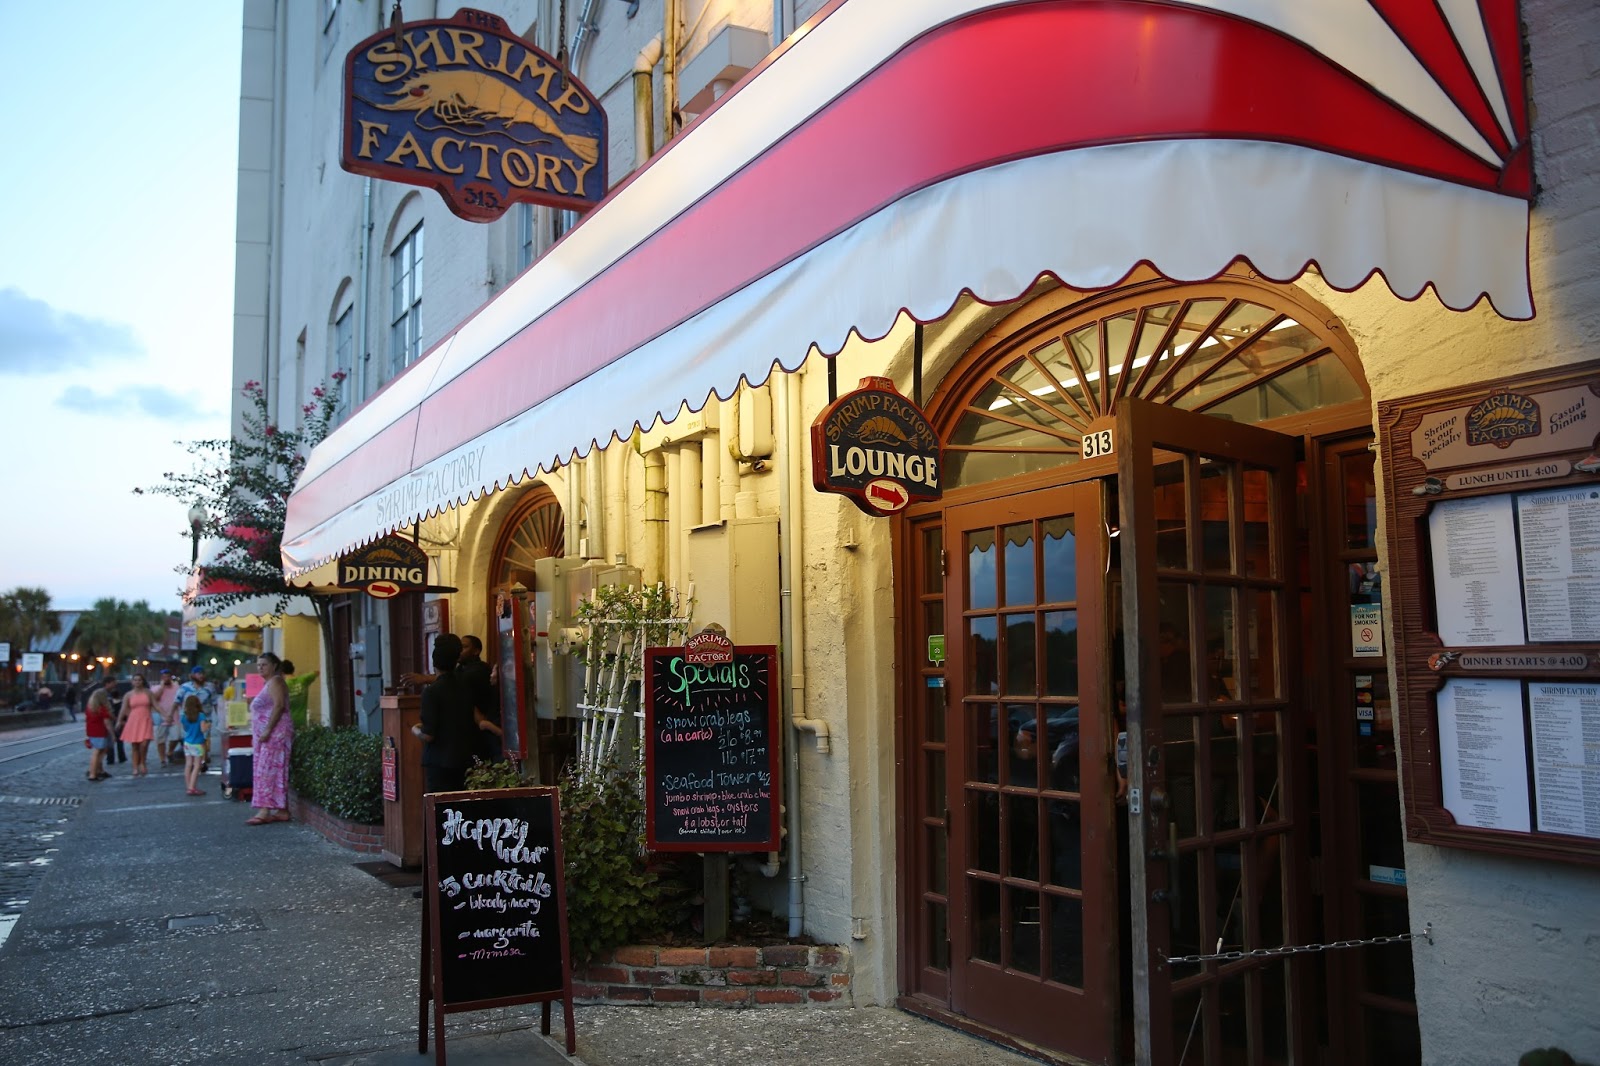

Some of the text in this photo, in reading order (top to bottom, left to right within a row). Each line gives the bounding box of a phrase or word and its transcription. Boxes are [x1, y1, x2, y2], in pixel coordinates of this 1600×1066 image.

[463, 10, 500, 29] THE
[366, 28, 590, 115] SHRIMP
[358, 119, 597, 197] FACTORY
[464, 188, 500, 208] 313
[873, 378, 892, 389] THE
[1471, 395, 1533, 422] SHRIMP
[1550, 396, 1585, 424] Casual
[826, 394, 939, 451] SHRIMP FACTORY
[1424, 416, 1457, 440] Shrimp
[1472, 422, 1536, 442] FACTORY
[1550, 409, 1587, 435] Dining
[1084, 431, 1112, 457] 313
[1421, 432, 1462, 461] Specialty
[1429, 428, 1453, 447] is our
[829, 444, 938, 489] LOUNGE
[1459, 464, 1558, 486] LUNCH UNTIL 4:00
[376, 446, 486, 526] SHRIMP FACTORY
[386, 538, 426, 564] FACTORY
[344, 566, 423, 584] DINING
[688, 634, 729, 649] SHRIMP
[688, 653, 730, 662] FACTORY
[1463, 656, 1584, 666] DINNER STARTS @ 4:00
[668, 657, 750, 706] Specials
[665, 709, 751, 731] snow crab legs
[665, 770, 714, 790] Seafood
[717, 772, 756, 786] Tower
[664, 792, 691, 806] jumbo
[726, 801, 759, 813] oysters
[442, 808, 529, 851] Happy
[732, 815, 748, 827] tail
[438, 875, 461, 898] $5
[469, 892, 541, 915] bloody mary
[473, 920, 541, 949] margarita
